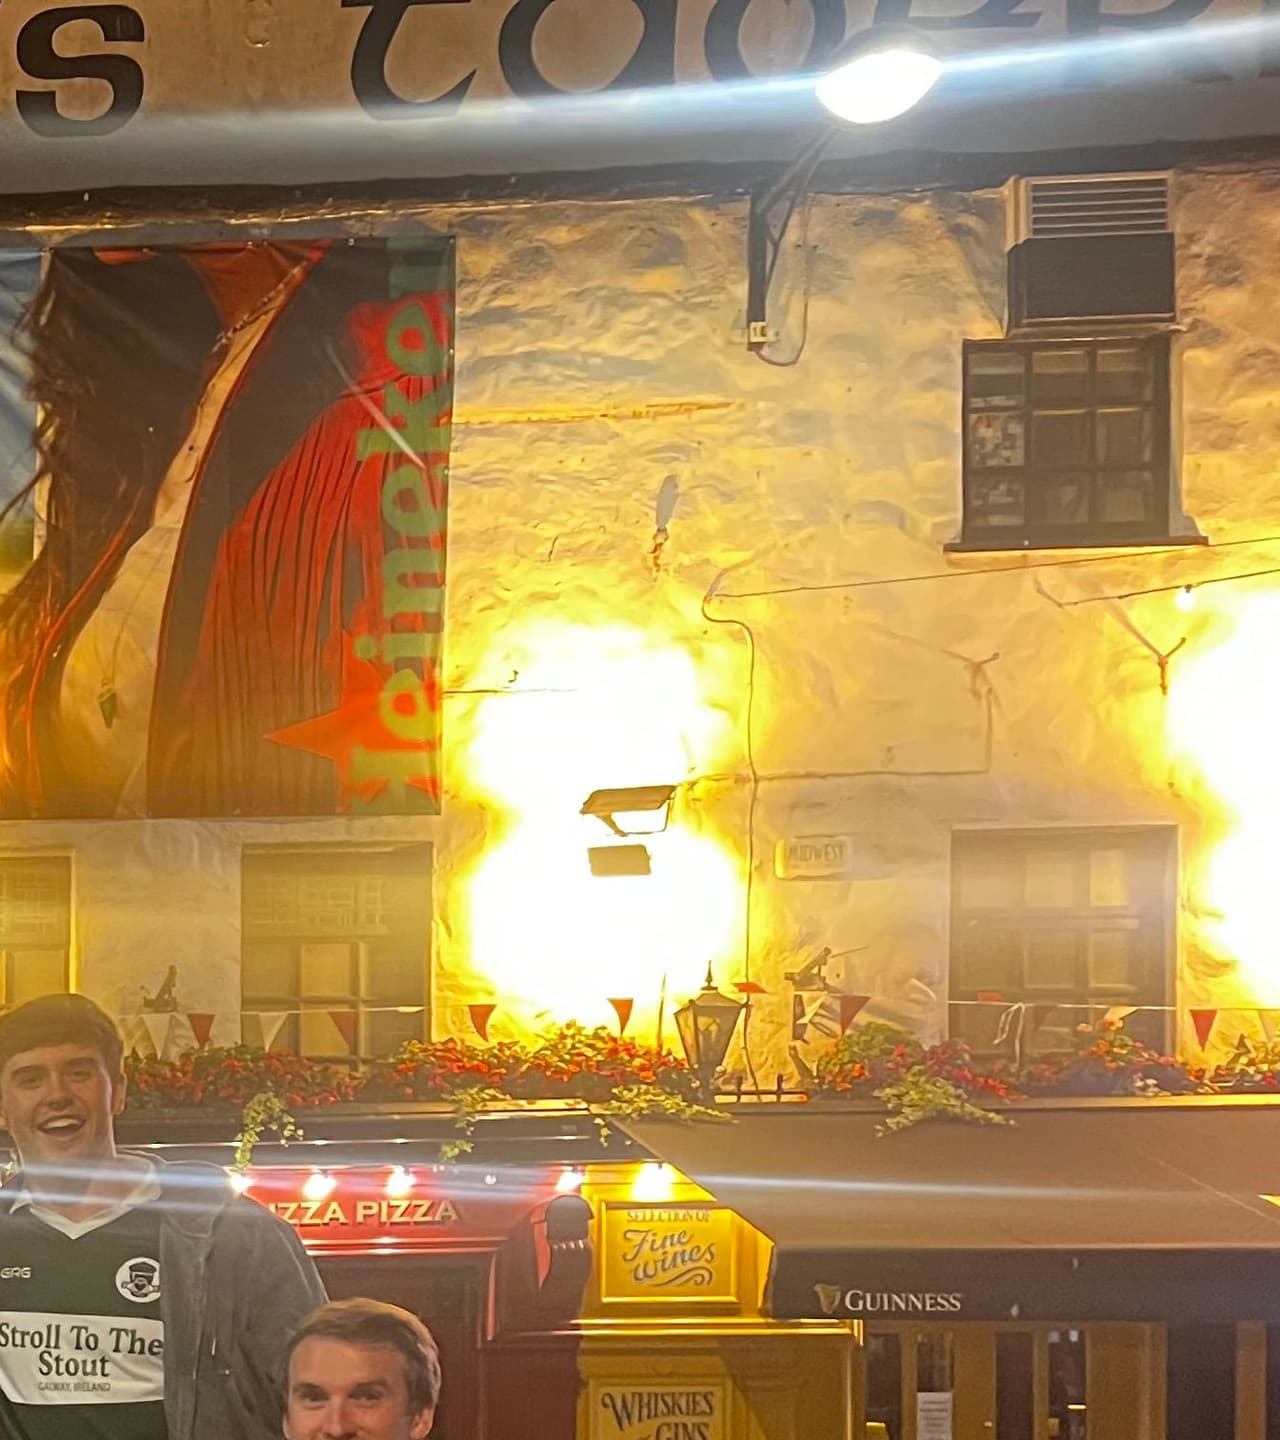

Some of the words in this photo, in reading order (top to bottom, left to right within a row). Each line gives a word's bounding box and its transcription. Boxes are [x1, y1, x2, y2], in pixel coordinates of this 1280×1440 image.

[266, 1200, 348, 1225] IZZA
[356, 1200, 459, 1223] PIZZA
[626, 1210, 694, 1223] SELECTION
[696, 1209, 712, 1222] OF
[622, 1228, 695, 1262] Fine
[844, 1289, 962, 1312] GUINNESS
[70, 1326, 99, 1351] To
[109, 1327, 164, 1356] The
[38, 1350, 112, 1377] Stout
[74, 1382, 111, 1393] IRELAND
[601, 1391, 715, 1431] WHISKIES
